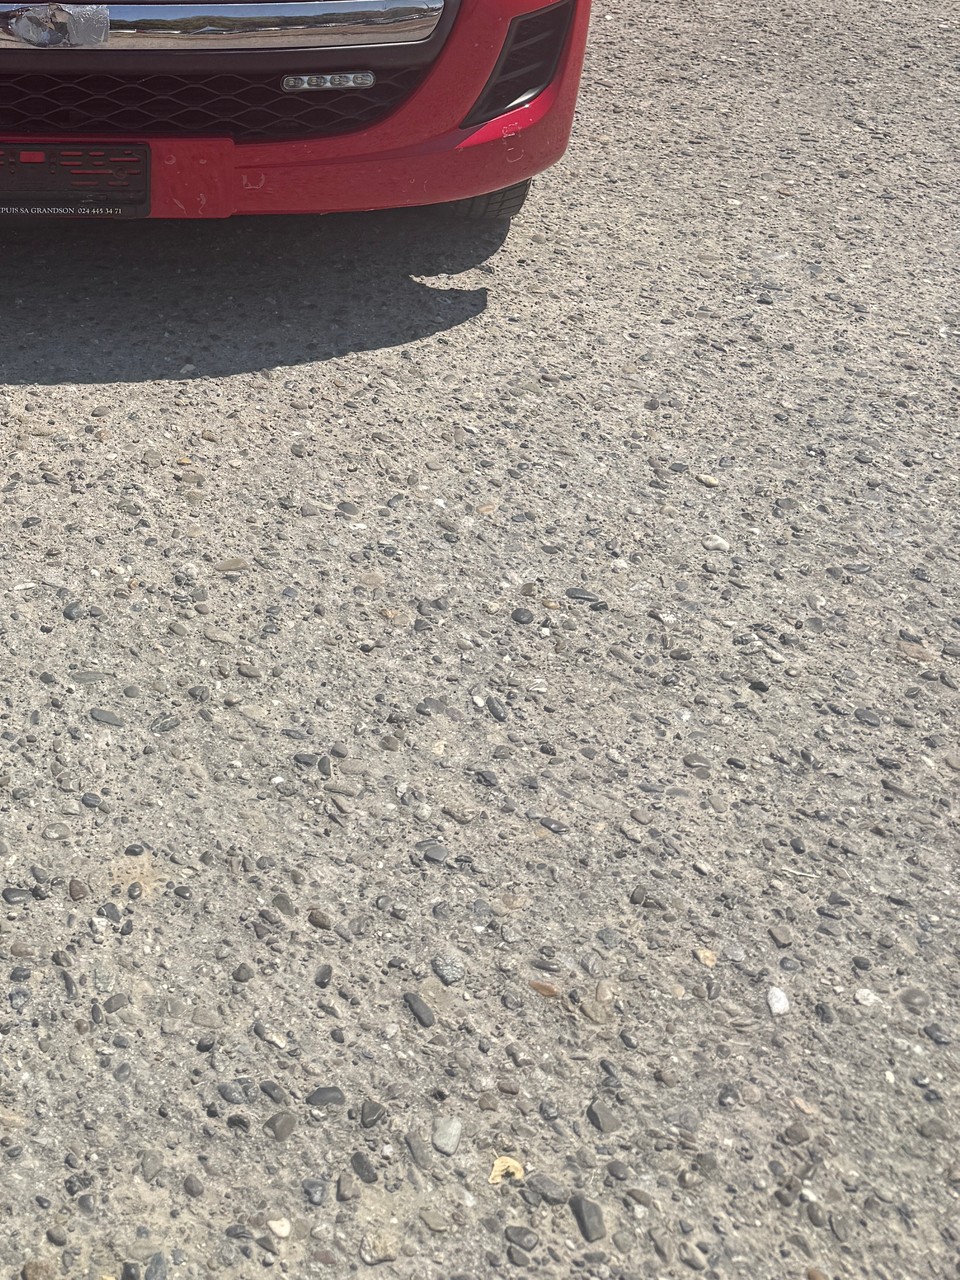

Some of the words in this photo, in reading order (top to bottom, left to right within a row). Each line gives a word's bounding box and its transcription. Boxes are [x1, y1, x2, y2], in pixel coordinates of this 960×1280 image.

[19, 206, 30, 214] SA
[30, 206, 75, 214] GRANDSON
[77, 207, 90, 215] 024
[91, 207, 104, 215] 445
